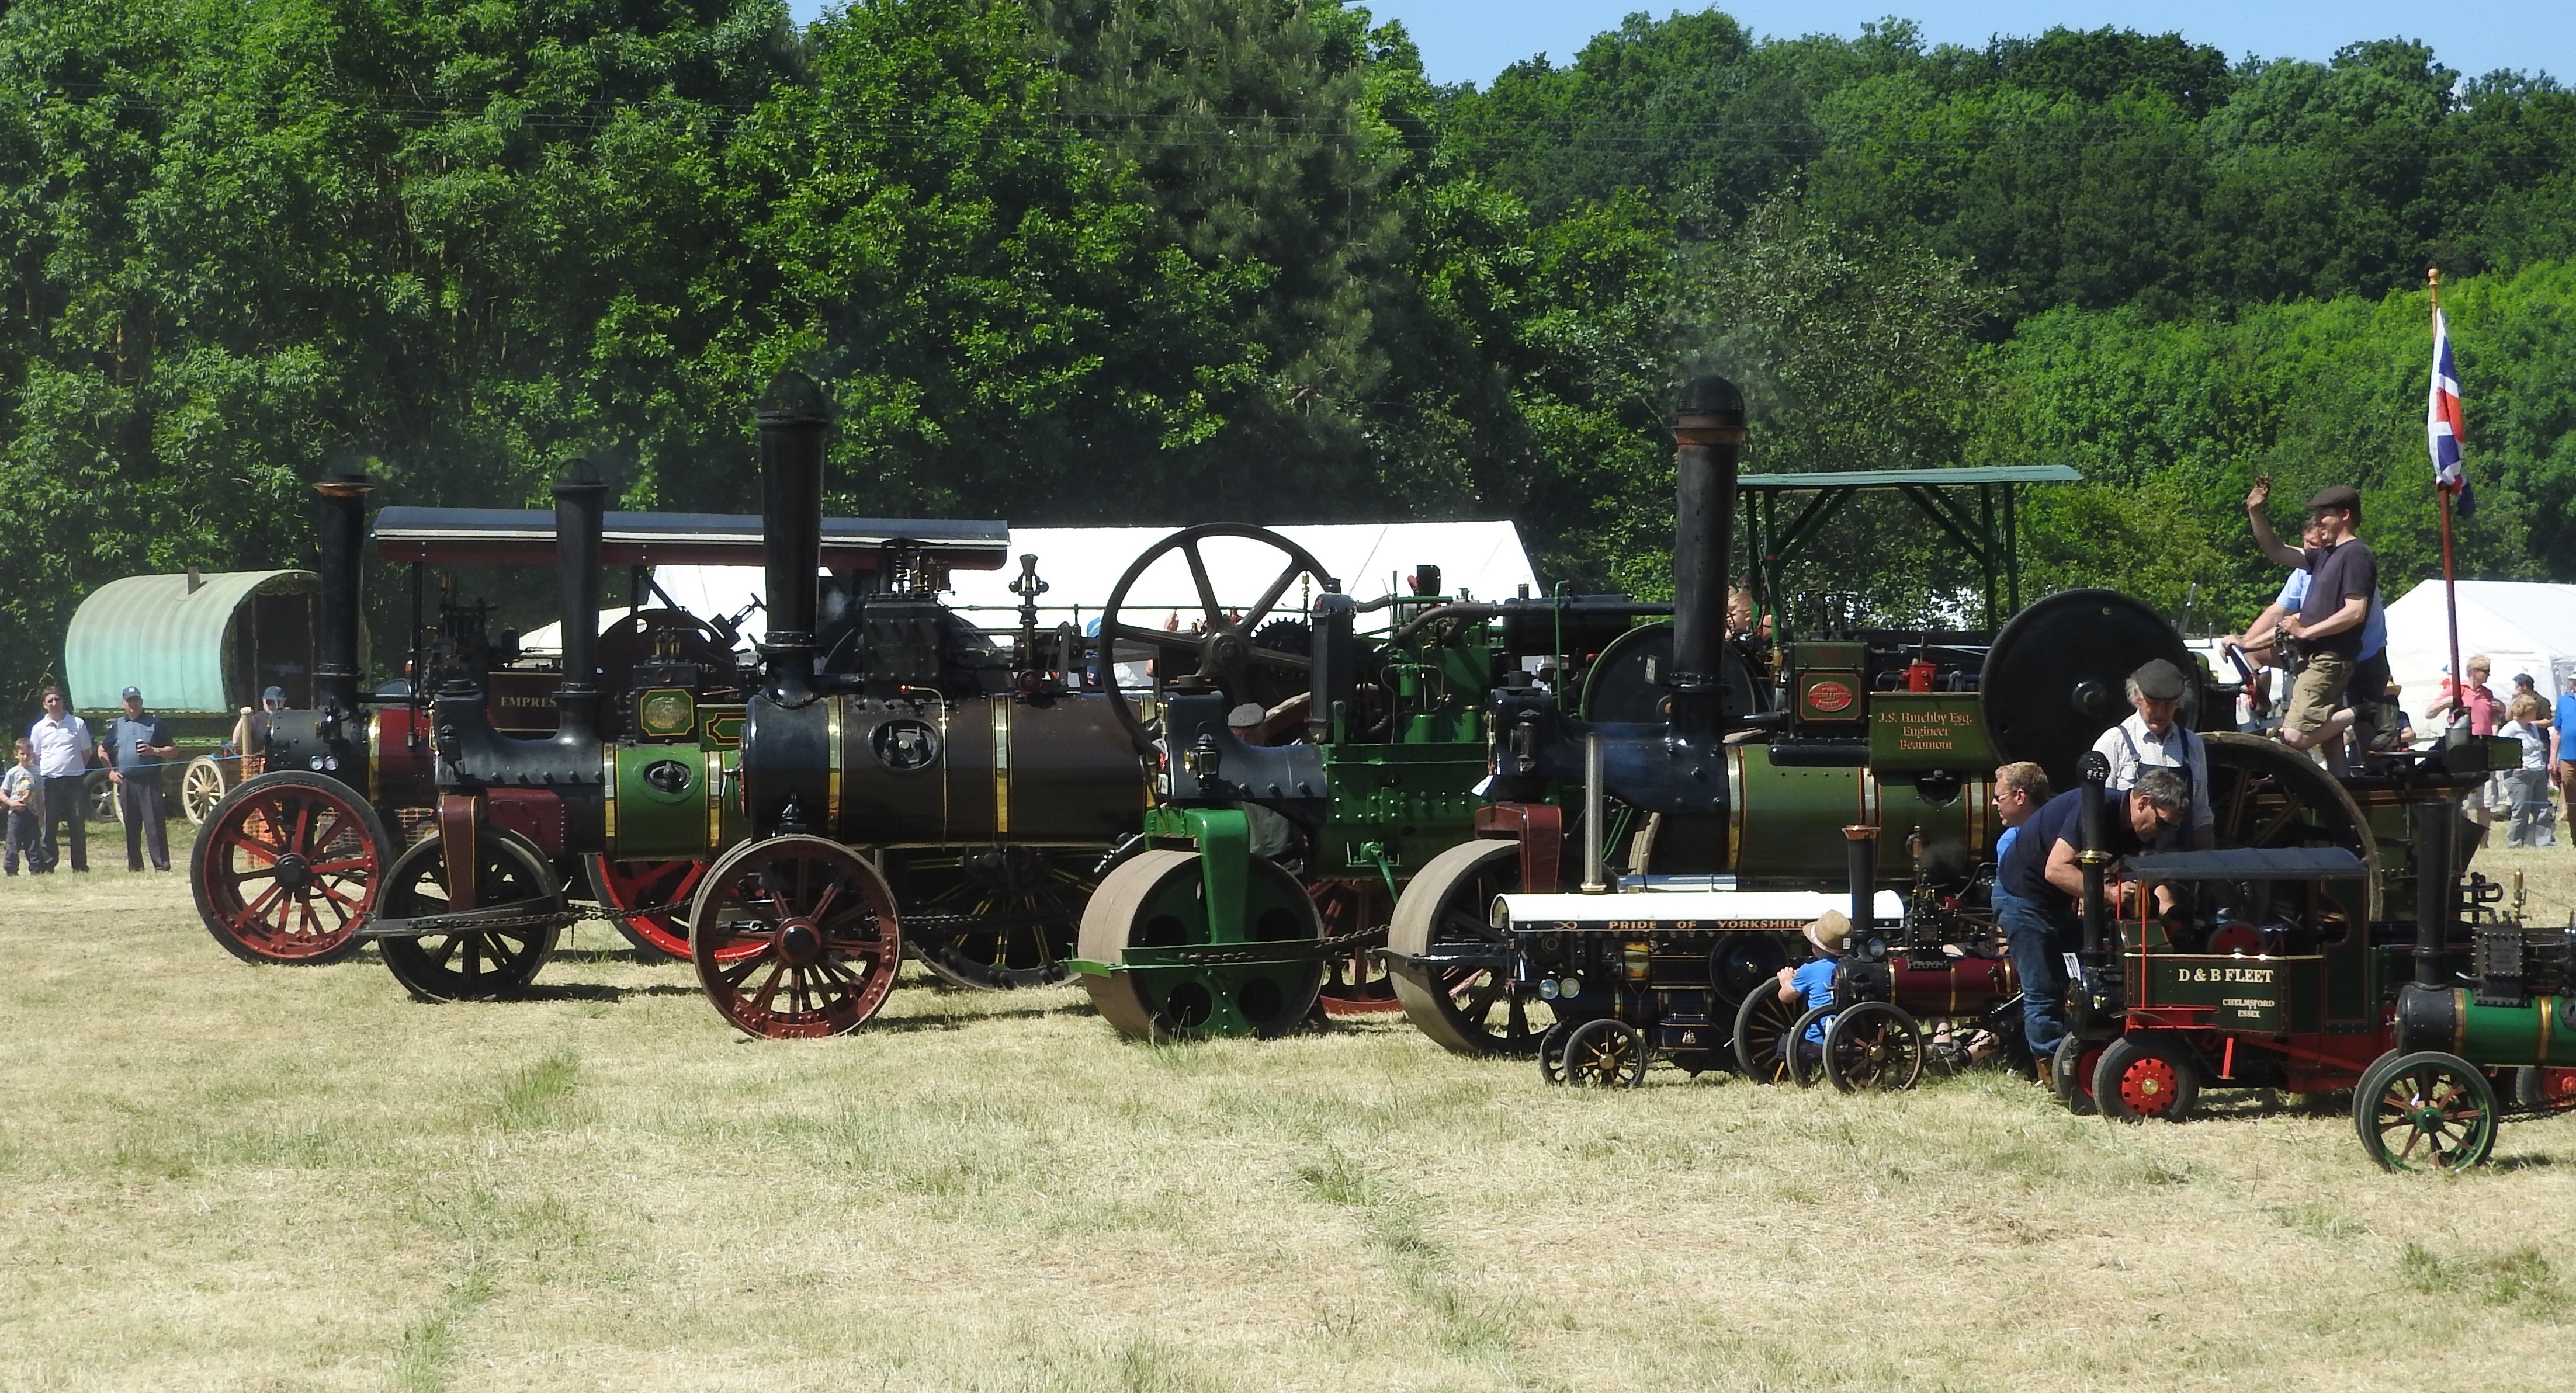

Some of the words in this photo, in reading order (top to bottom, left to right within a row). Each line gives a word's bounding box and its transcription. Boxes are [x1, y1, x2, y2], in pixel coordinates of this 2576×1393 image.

[501, 696, 557, 708] EMPRES
[1878, 713, 1897, 723] J.S.
[1950, 712, 1972, 725] Esq.
[1903, 726, 1950, 739] Engineer
[1899, 739, 1953, 750] Beaumont
[1608, 921, 1657, 929] PRIDE
[1717, 920, 1805, 929] YORKSHIRE
[2178, 968, 2190, 982] D
[2194, 968, 2207, 982] &
[2210, 968, 2221, 982] B
[2225, 968, 2274, 983] FLEET
[2222, 998, 2275, 1008] CHELMSFORD
[2237, 1009, 2260, 1018] ESSEX
